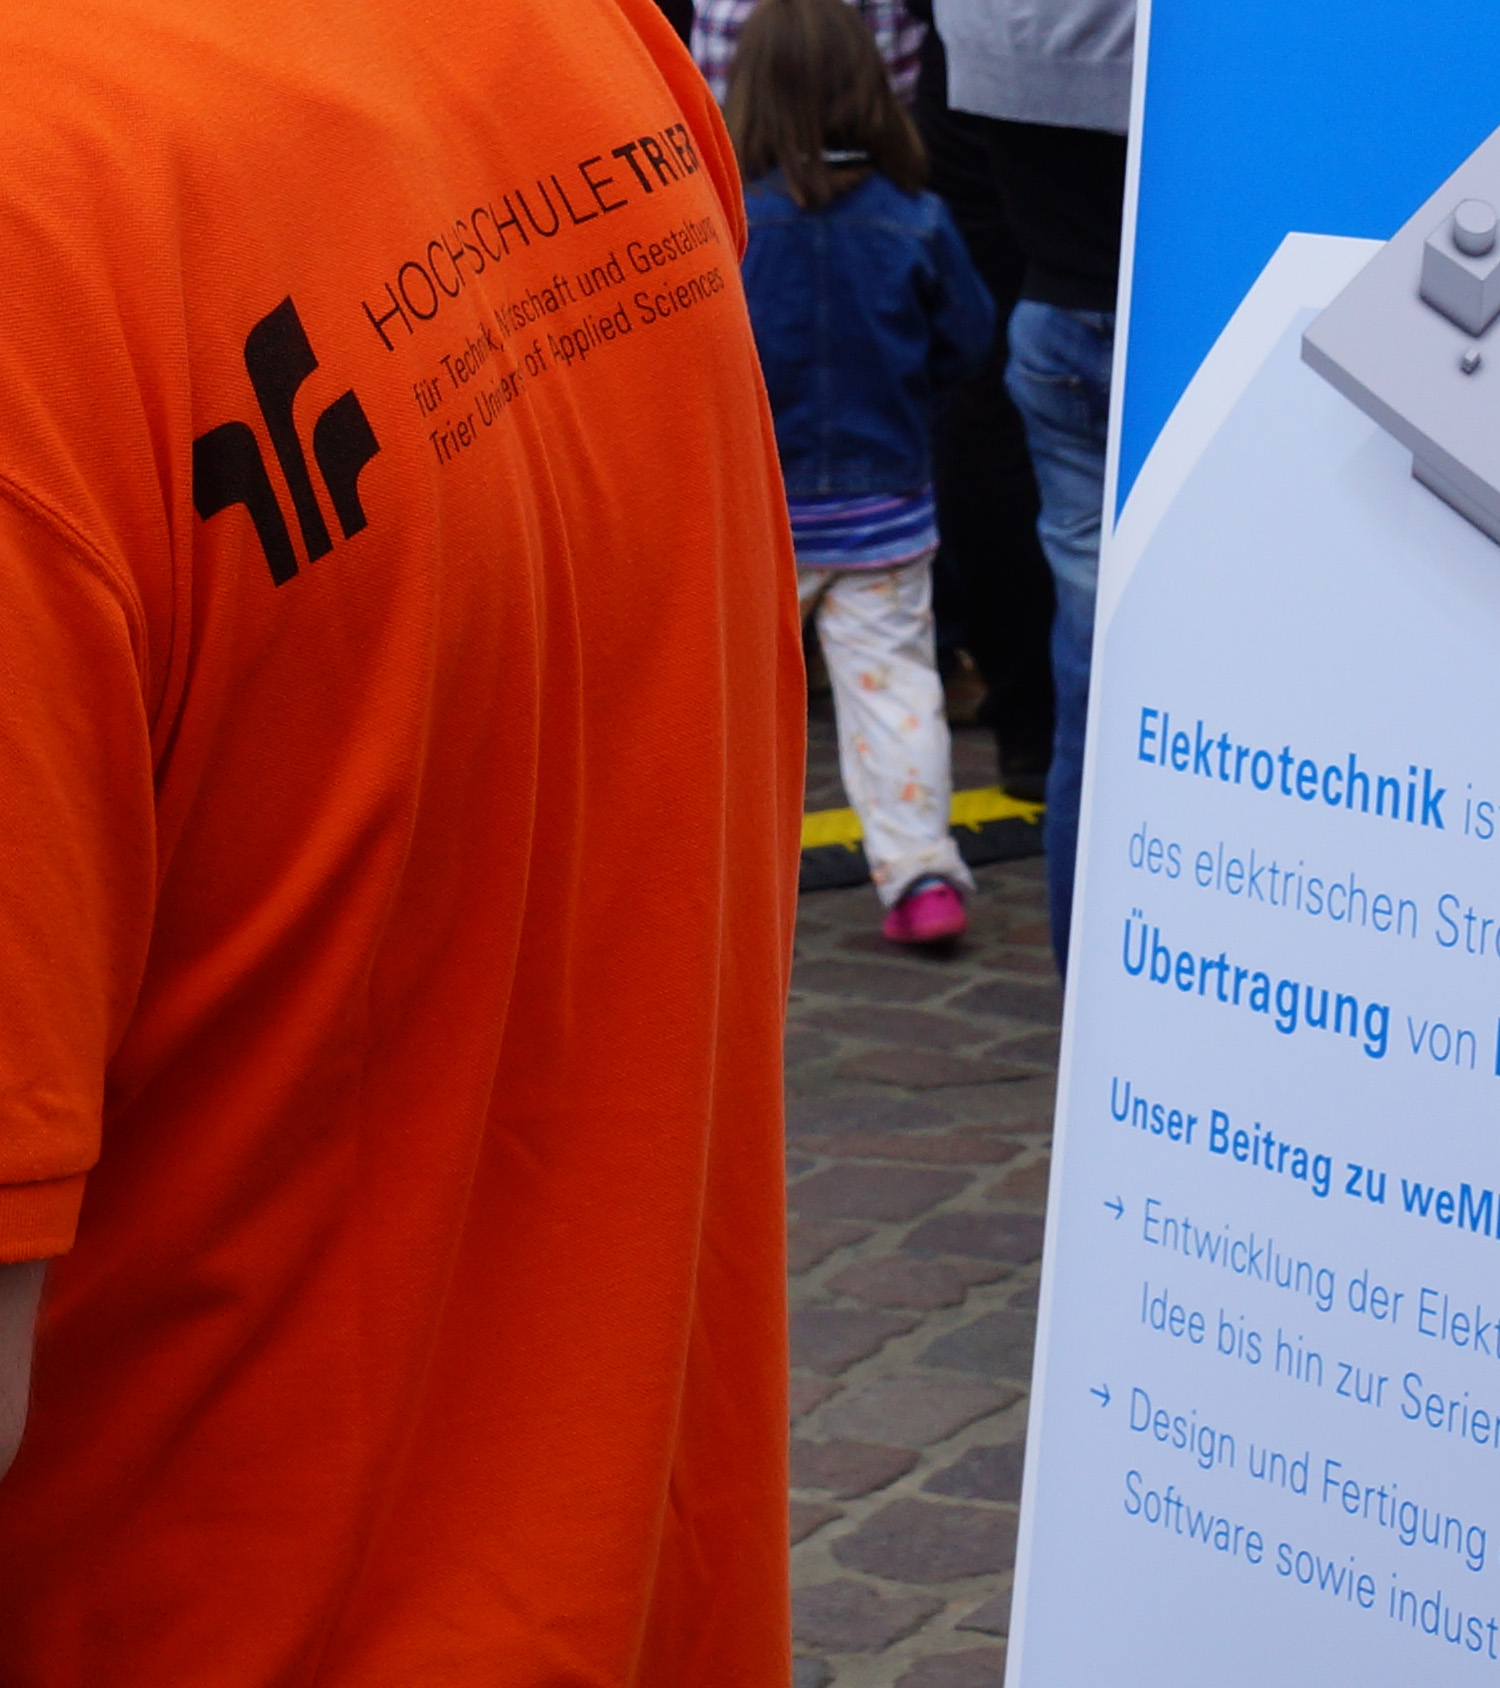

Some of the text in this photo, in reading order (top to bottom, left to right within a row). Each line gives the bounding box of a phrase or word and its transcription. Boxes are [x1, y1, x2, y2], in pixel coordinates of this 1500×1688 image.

[361, 155, 629, 352] HOCHSCHULE
[413, 376, 443, 418] für
[577, 251, 626, 297] und
[429, 413, 477, 465] Trier
[523, 339, 547, 377] of
[547, 301, 633, 366] Applied
[633, 266, 725, 325] Sciences
[1139, 707, 1446, 829] Elektrotechnik
[1130, 822, 1181, 879] des
[1195, 842, 1417, 938] elektrischen
[1124, 908, 1389, 1059] Übertragung
[1408, 1017, 1476, 1069] von
[1112, 1078, 1198, 1144] Unser
[1210, 1110, 1331, 1197] Beitrag
[1346, 1164, 1386, 1204] zu
[1143, 1198, 1335, 1312] Entwicklung
[1349, 1269, 1404, 1323] der
[1142, 1282, 1205, 1344] Idee
[1218, 1309, 1262, 1365] bis
[1276, 1328, 1323, 1386] hin
[1336, 1362, 1389, 1407] zur
[1125, 1470, 1263, 1564] Software
[1276, 1543, 1375, 1608] sowie
[1130, 1387, 1235, 1470] Design
[1249, 1445, 1309, 1496] und
[1323, 1459, 1486, 1572] Fertigung
